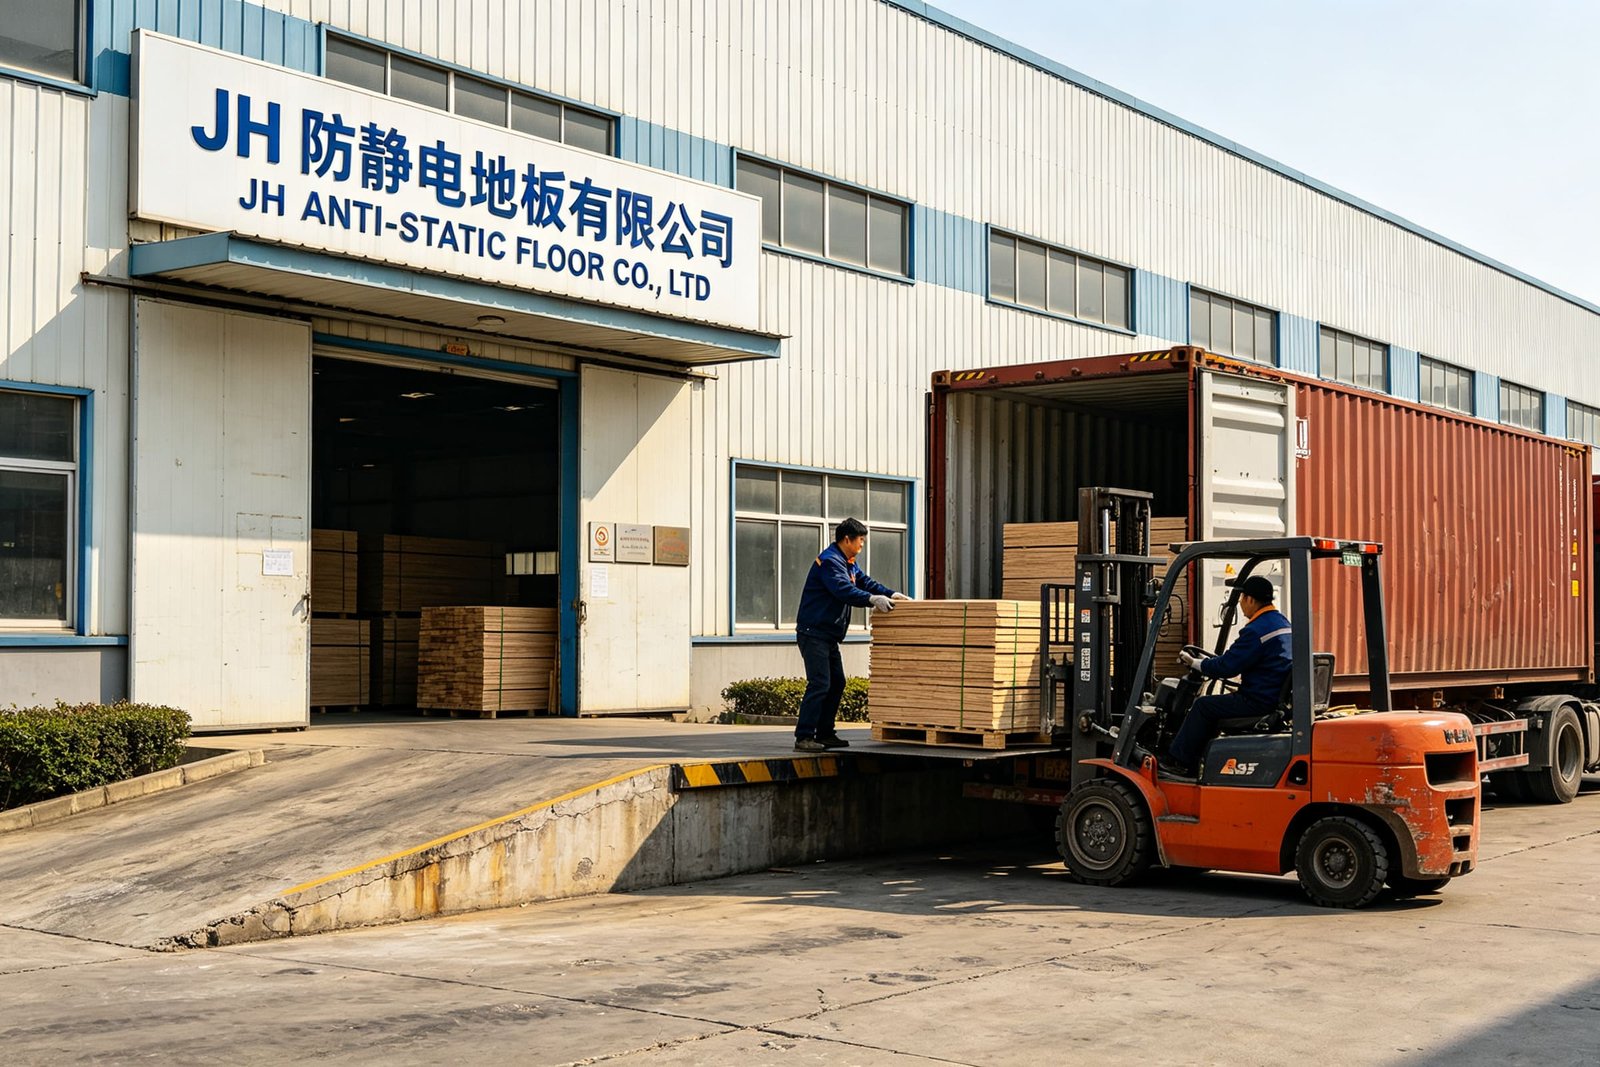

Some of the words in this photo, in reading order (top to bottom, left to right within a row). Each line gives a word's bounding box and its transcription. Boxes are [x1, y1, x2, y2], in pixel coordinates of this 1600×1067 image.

[191, 88, 281, 165] JH
[301, 108, 734, 269] 防静电地板有限公司
[239, 179, 286, 217] JH
[302, 191, 506, 260] ANTI-STATIC
[516, 236, 604, 281] FLOOR
[613, 258, 663, 300] CO.,
[668, 271, 711, 302] LTD
